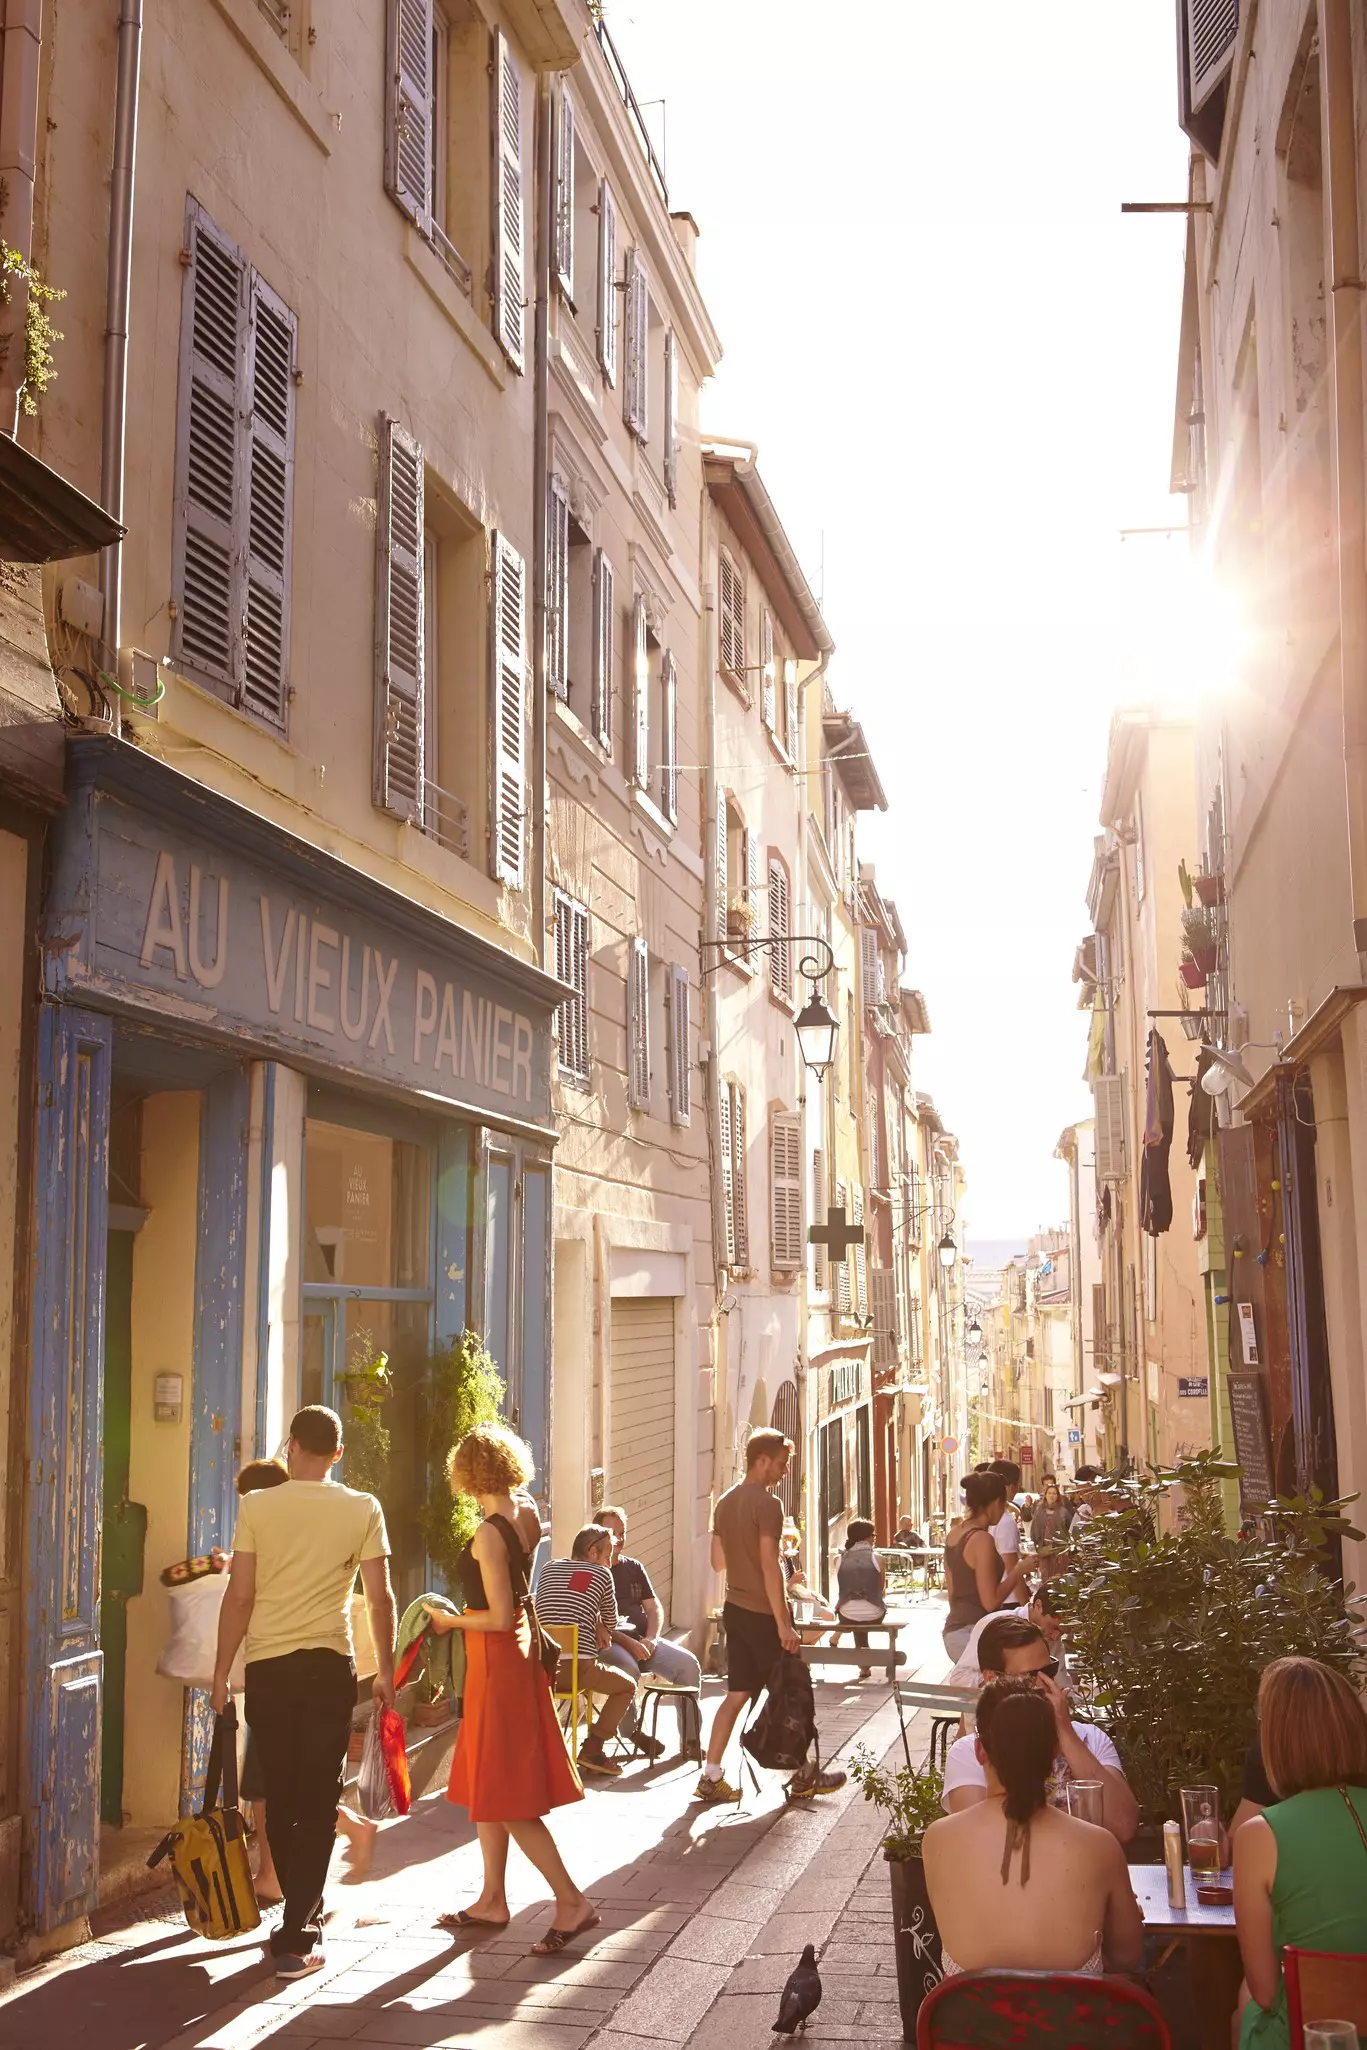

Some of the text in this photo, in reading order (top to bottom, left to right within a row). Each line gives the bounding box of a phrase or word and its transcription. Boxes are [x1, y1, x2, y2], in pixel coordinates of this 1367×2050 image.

[139, 850, 533, 1102] AU VIEUX PANIER
[353, 1164, 362, 1177] AU
[348, 1177, 367, 1191] VIEUX
[346, 1190, 370, 1205] PANIER
